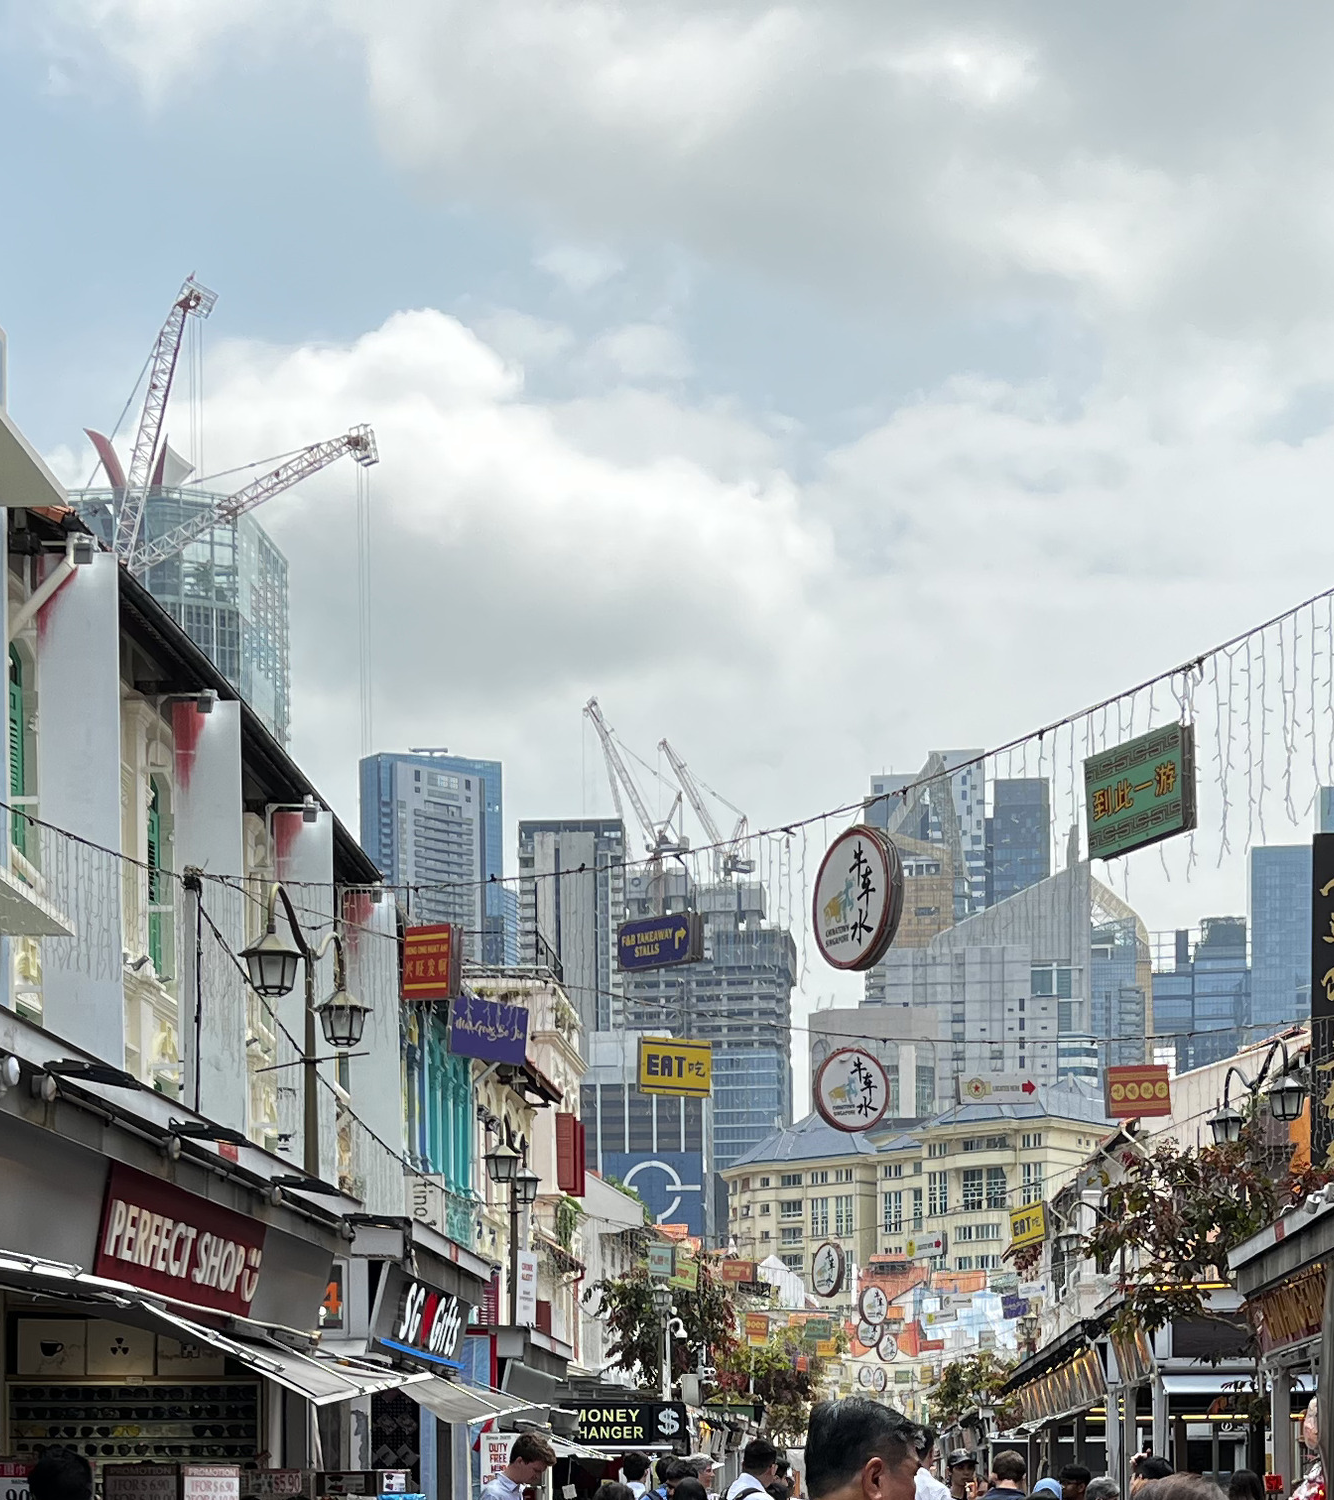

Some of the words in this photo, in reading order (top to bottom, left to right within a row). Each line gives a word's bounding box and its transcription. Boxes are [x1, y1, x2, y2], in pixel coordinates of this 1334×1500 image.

[1092, 760, 1177, 822] 到此一游
[622, 936, 636, 947] F&B
[637, 928, 674, 944] TAKEAWAY
[825, 924, 850, 938] CHINATOWN
[825, 933, 850, 949] SINGAPORE
[634, 944, 660, 957] STALLS
[646, 1053, 686, 1078] EAT
[688, 1061, 706, 1078] 吃
[1012, 1216, 1032, 1236] EAT
[104, 1199, 198, 1279] PERFECT
[191, 1231, 247, 1294] SHOP
[398, 1282, 426, 1344] SG
[428, 1295, 462, 1357] Gifts
[579, 1426, 644, 1439] HANGER
[488, 1442, 508, 1453] DUTY
[489, 1453, 507, 1463] FREE
[110, 1466, 172, 1475] PROMOTION
[188, 1467, 236, 1477] PROMOTION
[273, 1473, 301, 1493] $5.90
